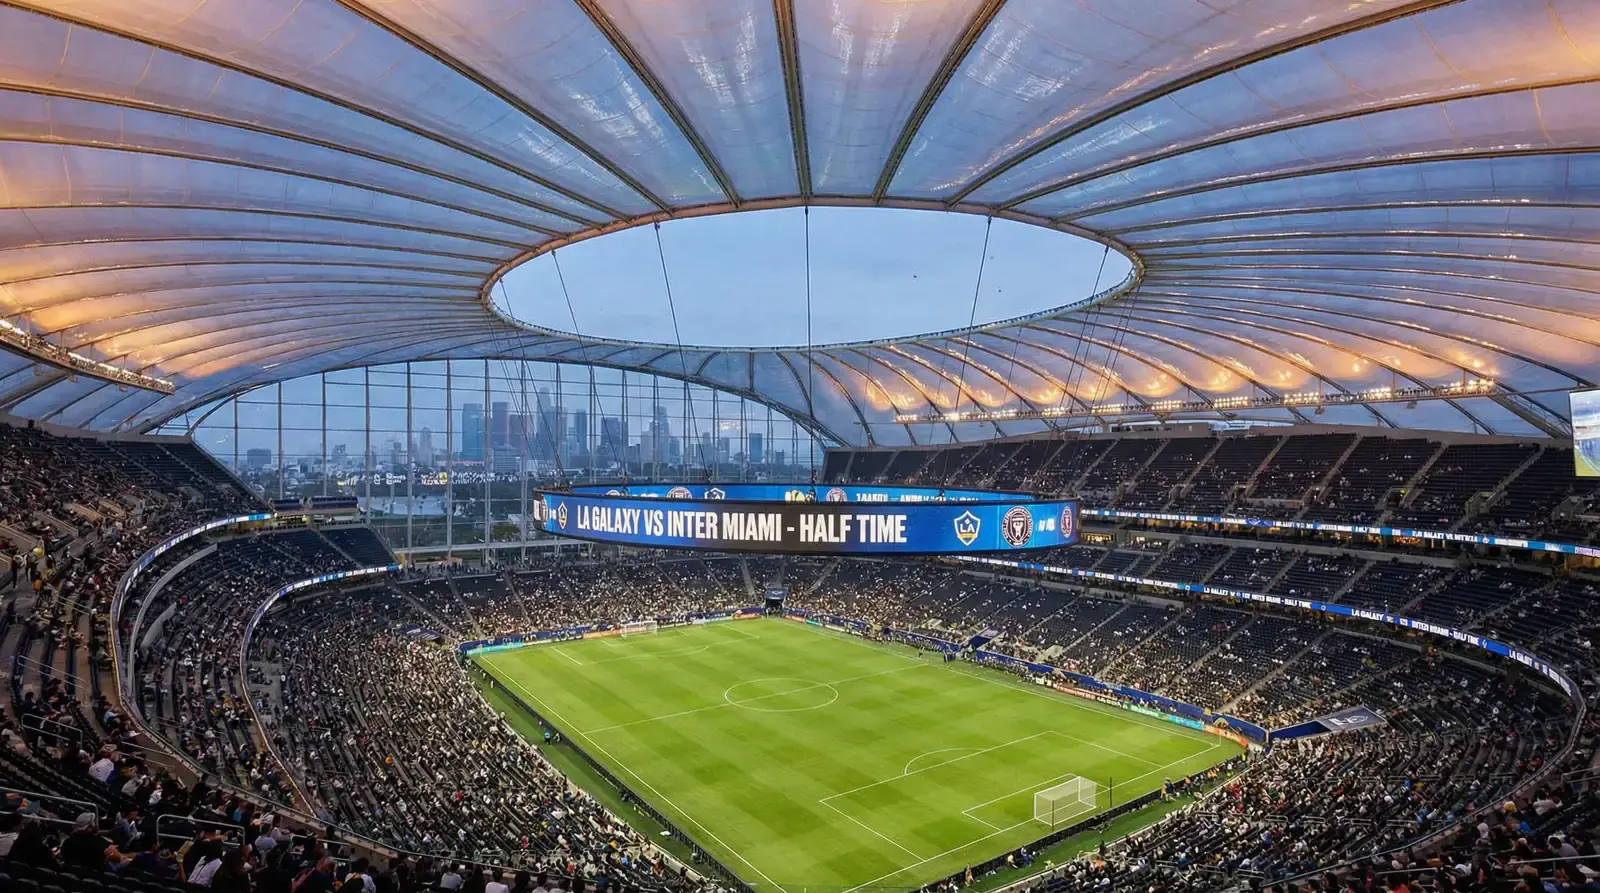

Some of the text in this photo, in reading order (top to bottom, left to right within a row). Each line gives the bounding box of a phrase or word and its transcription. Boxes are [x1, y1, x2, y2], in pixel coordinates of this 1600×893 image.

[577, 505, 590, 530] LA
[592, 506, 641, 535] GALAXY
[643, 509, 664, 536] VS
[667, 511, 718, 540] INTER
[722, 512, 782, 542] MIAMI
[800, 513, 852, 543] HALF
[856, 514, 907, 543] TIME
[960, 523, 975, 533] LA
